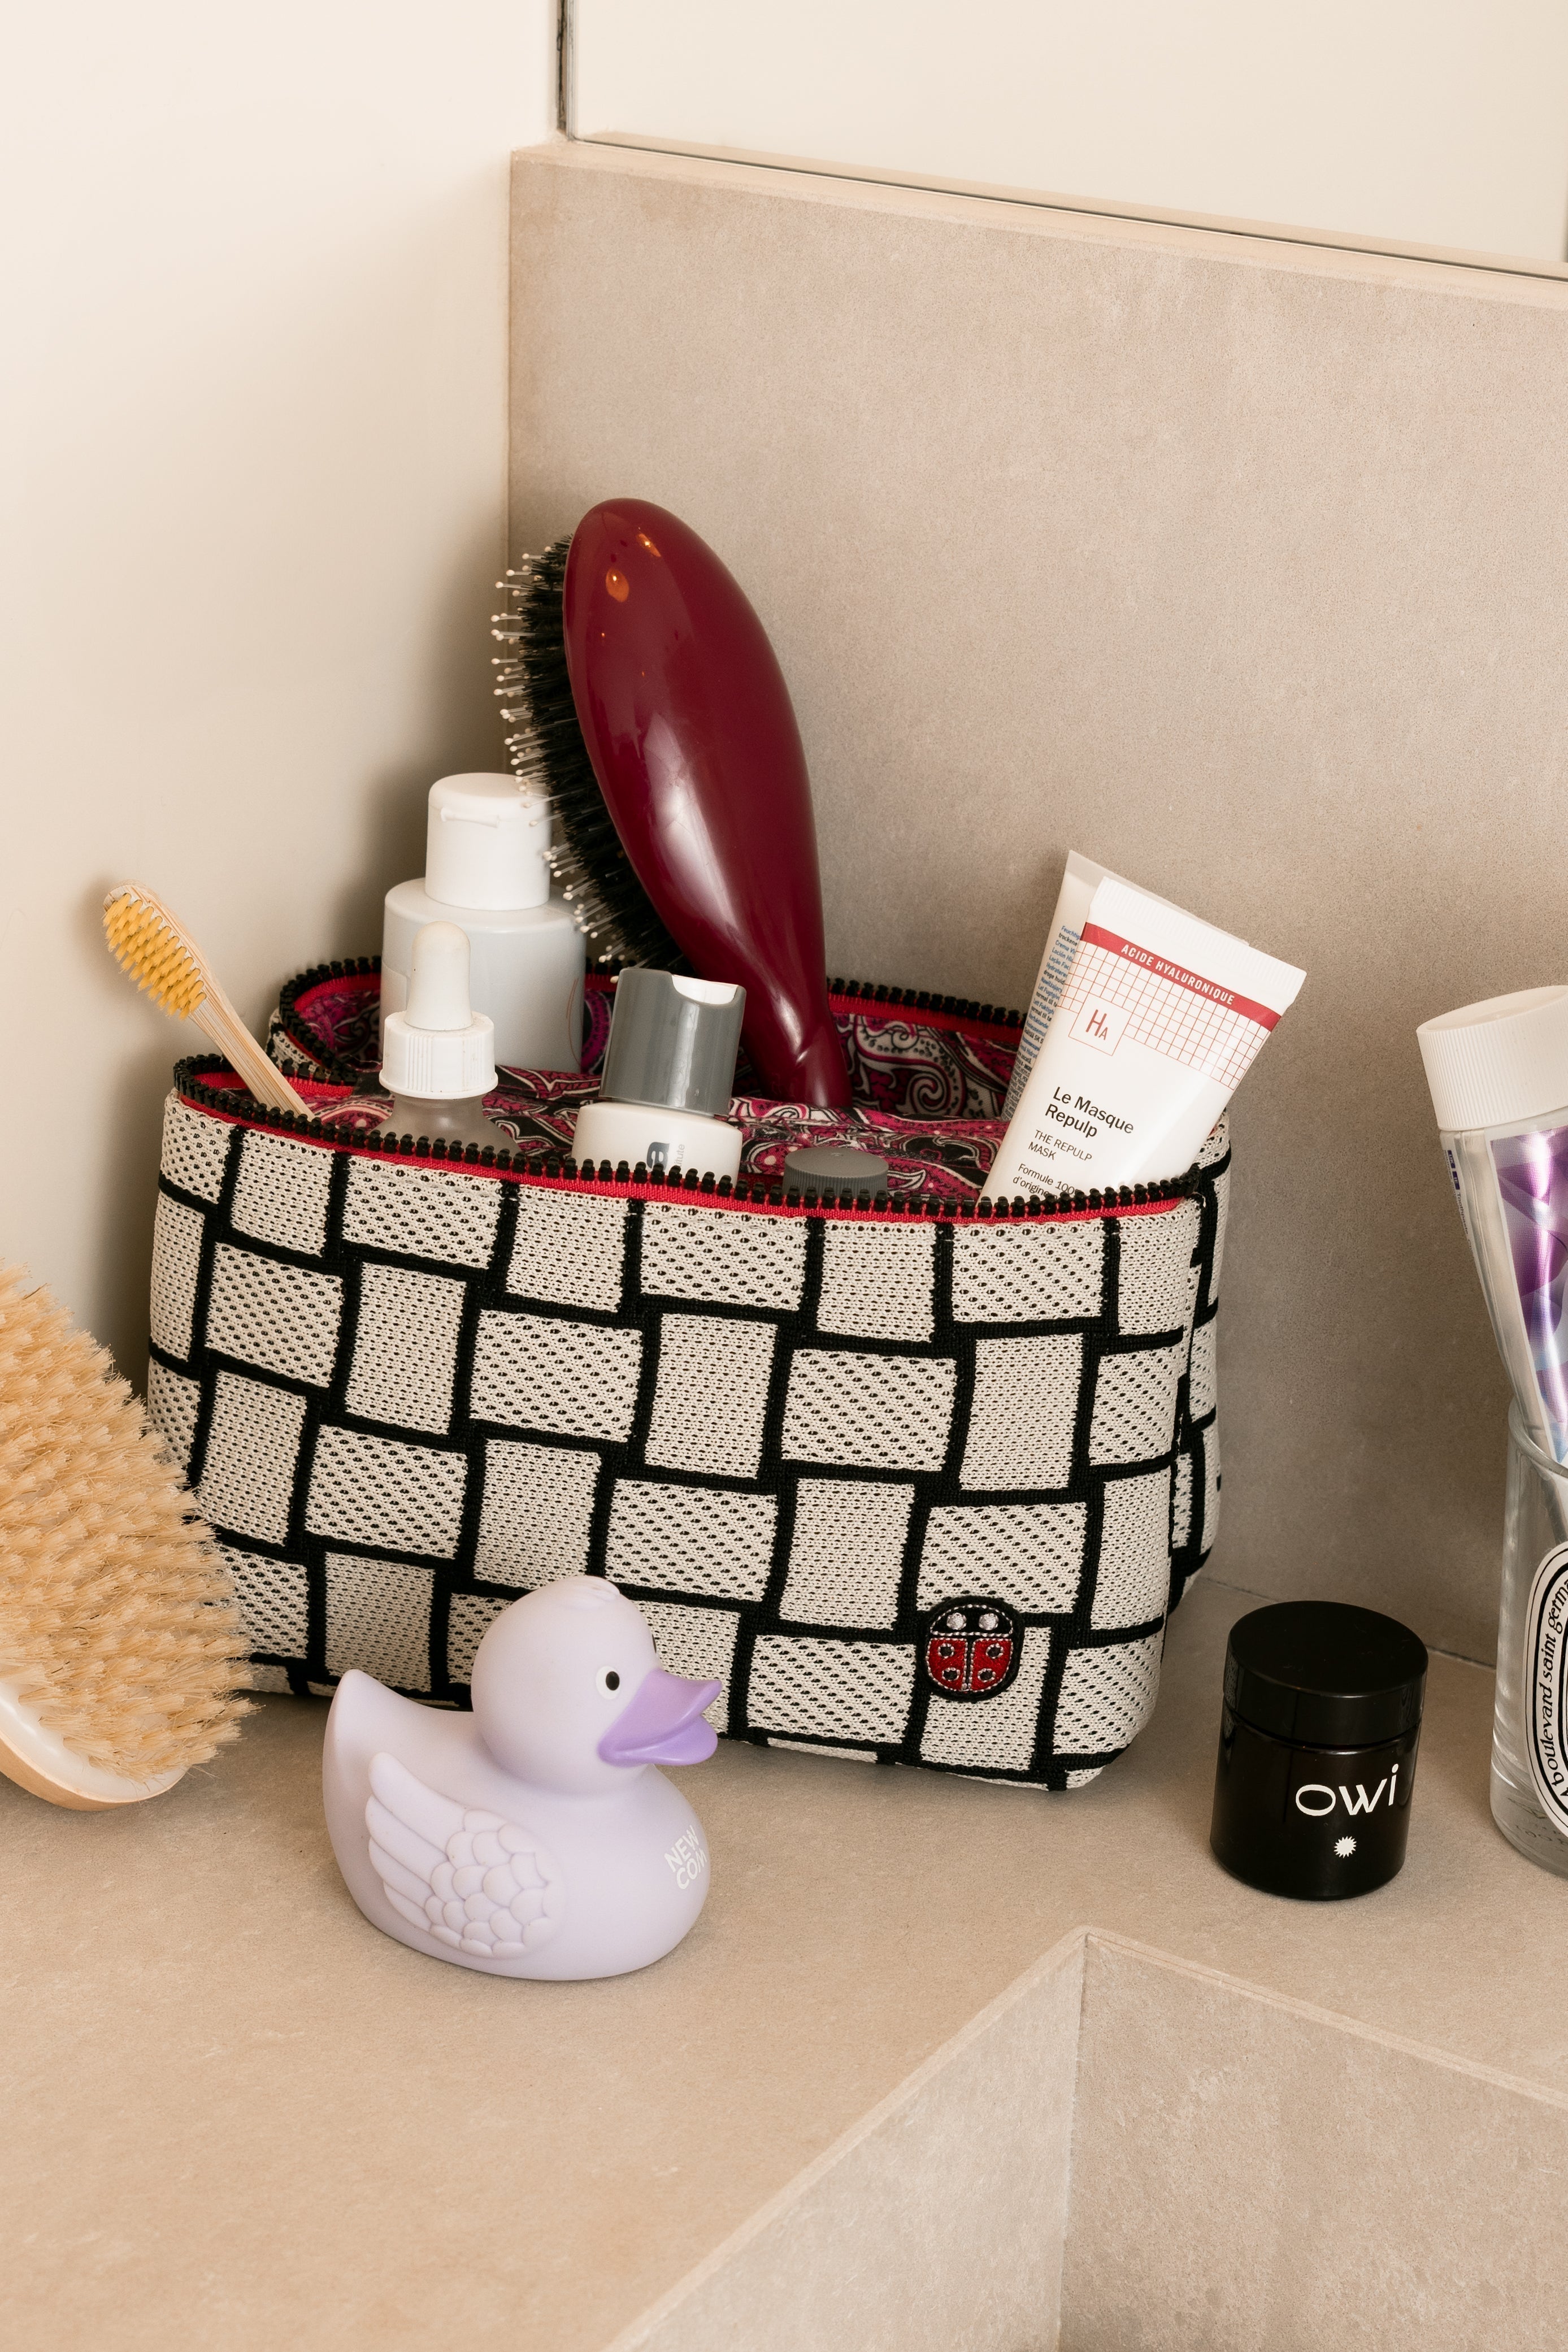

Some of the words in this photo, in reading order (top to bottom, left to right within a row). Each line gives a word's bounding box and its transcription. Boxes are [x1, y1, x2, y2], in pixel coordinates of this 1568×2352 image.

[1121, 944, 1154, 966] ACIDE
[1156, 960, 1235, 1005] HYALURONIQUE
[1045, 1104, 1098, 1138] Repulp
[1053, 1086, 1071, 1104] Le
[1074, 1096, 1134, 1134] Masque
[675, 1144, 685, 1167] itute
[1028, 1142, 1057, 1161] MASK
[1033, 1129, 1054, 1144] THE
[1054, 1139, 1093, 1161] REPULP
[1018, 1163, 1054, 1186] Formule
[1457, 1192, 1468, 1235] Toothpaste
[1541, 1633, 1557, 1682] saint
[1539, 1681, 1565, 1787] boulevard
[1296, 1764, 1399, 1817] owi
[664, 1825, 699, 1873] NEW
